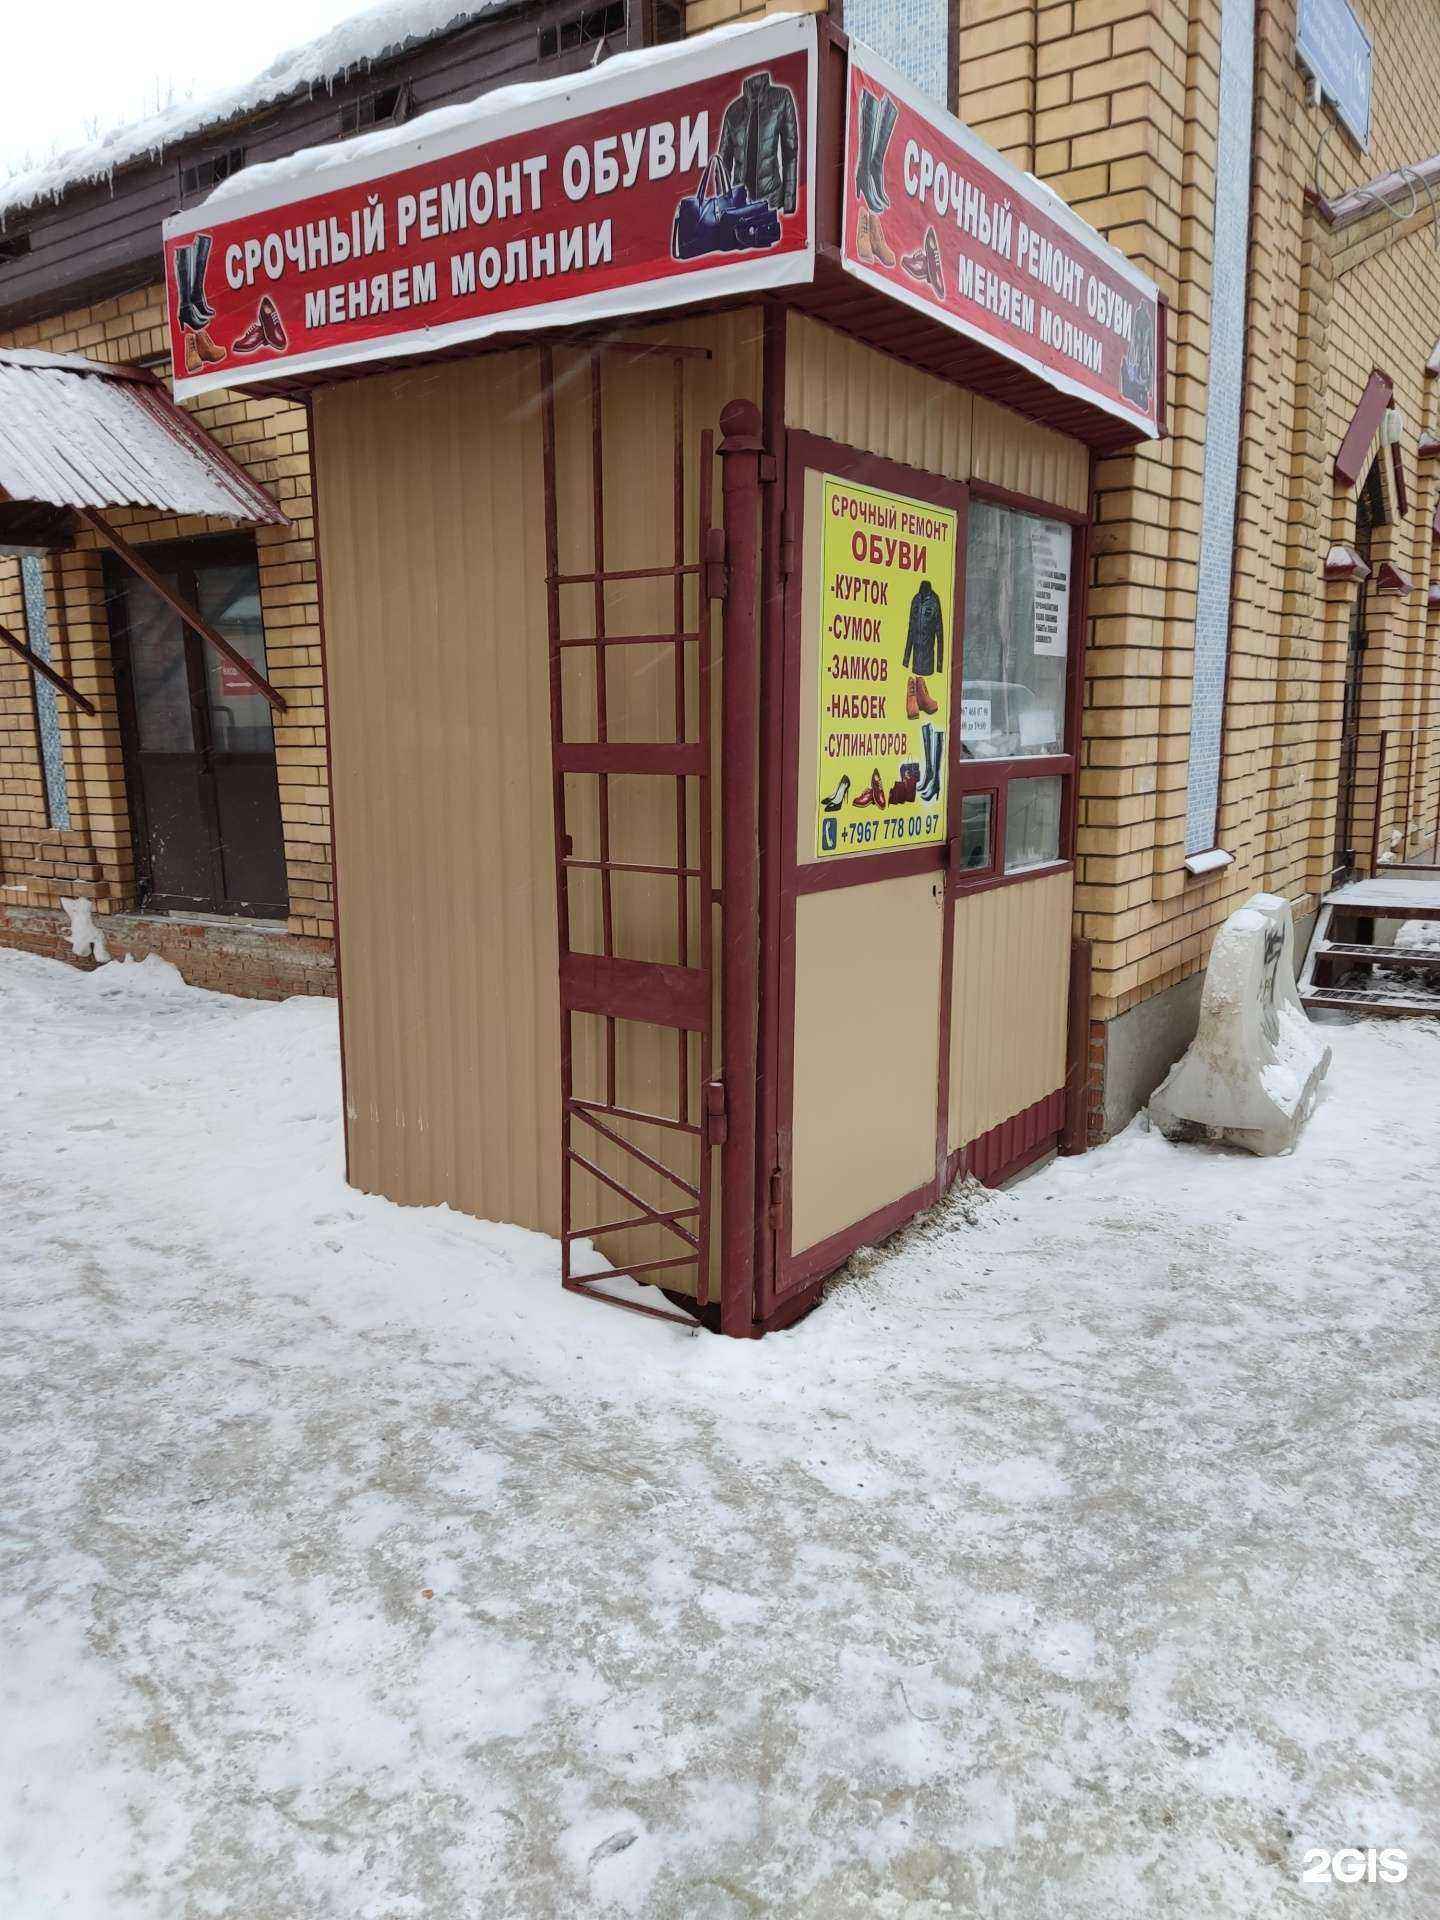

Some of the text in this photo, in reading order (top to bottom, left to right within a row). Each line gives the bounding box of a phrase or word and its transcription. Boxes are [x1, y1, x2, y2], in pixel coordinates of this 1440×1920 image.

[225, 111, 709, 290] СРОЧНЫЙ РЕМОНТ ОБУВИ
[904, 139, 1132, 342] СРОЧНЫЙ РЕМОНТ ОБУВИ
[305, 219, 613, 329] МЕНЯЕМ МОЛНИИ
[958, 254, 1103, 374] МЕНЯЕМ МОЛНИИ
[832, 494, 948, 541] СРОЧНЫЙ РЕМОНТ
[851, 530, 927, 573] ОБУВИ
[831, 574, 888, 605] -КУРТОК
[829, 614, 881, 642] -СУМОК
[828, 654, 888, 681] -ЗАМКОВ
[827, 694, 886, 719] -НАБОЕК
[825, 733, 907, 757] -СУПИНАТОРОВ
[841, 815, 939, 844] +7967 778 00 97
